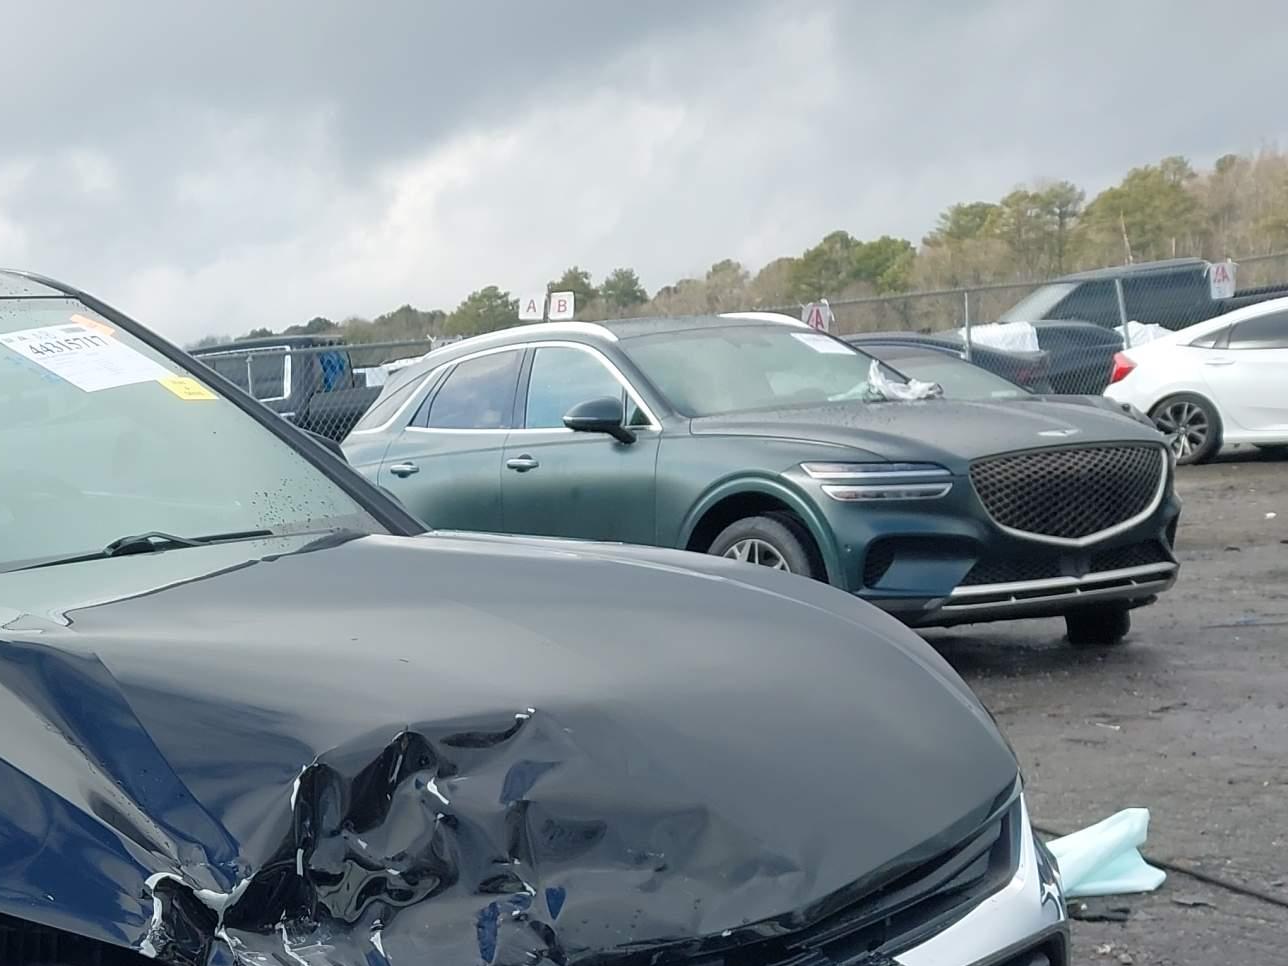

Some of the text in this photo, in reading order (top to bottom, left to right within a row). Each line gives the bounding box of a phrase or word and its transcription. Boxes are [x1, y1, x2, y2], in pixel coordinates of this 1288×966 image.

[526, 298, 567, 313] A B
[28, 335, 110, 356] 44315717
